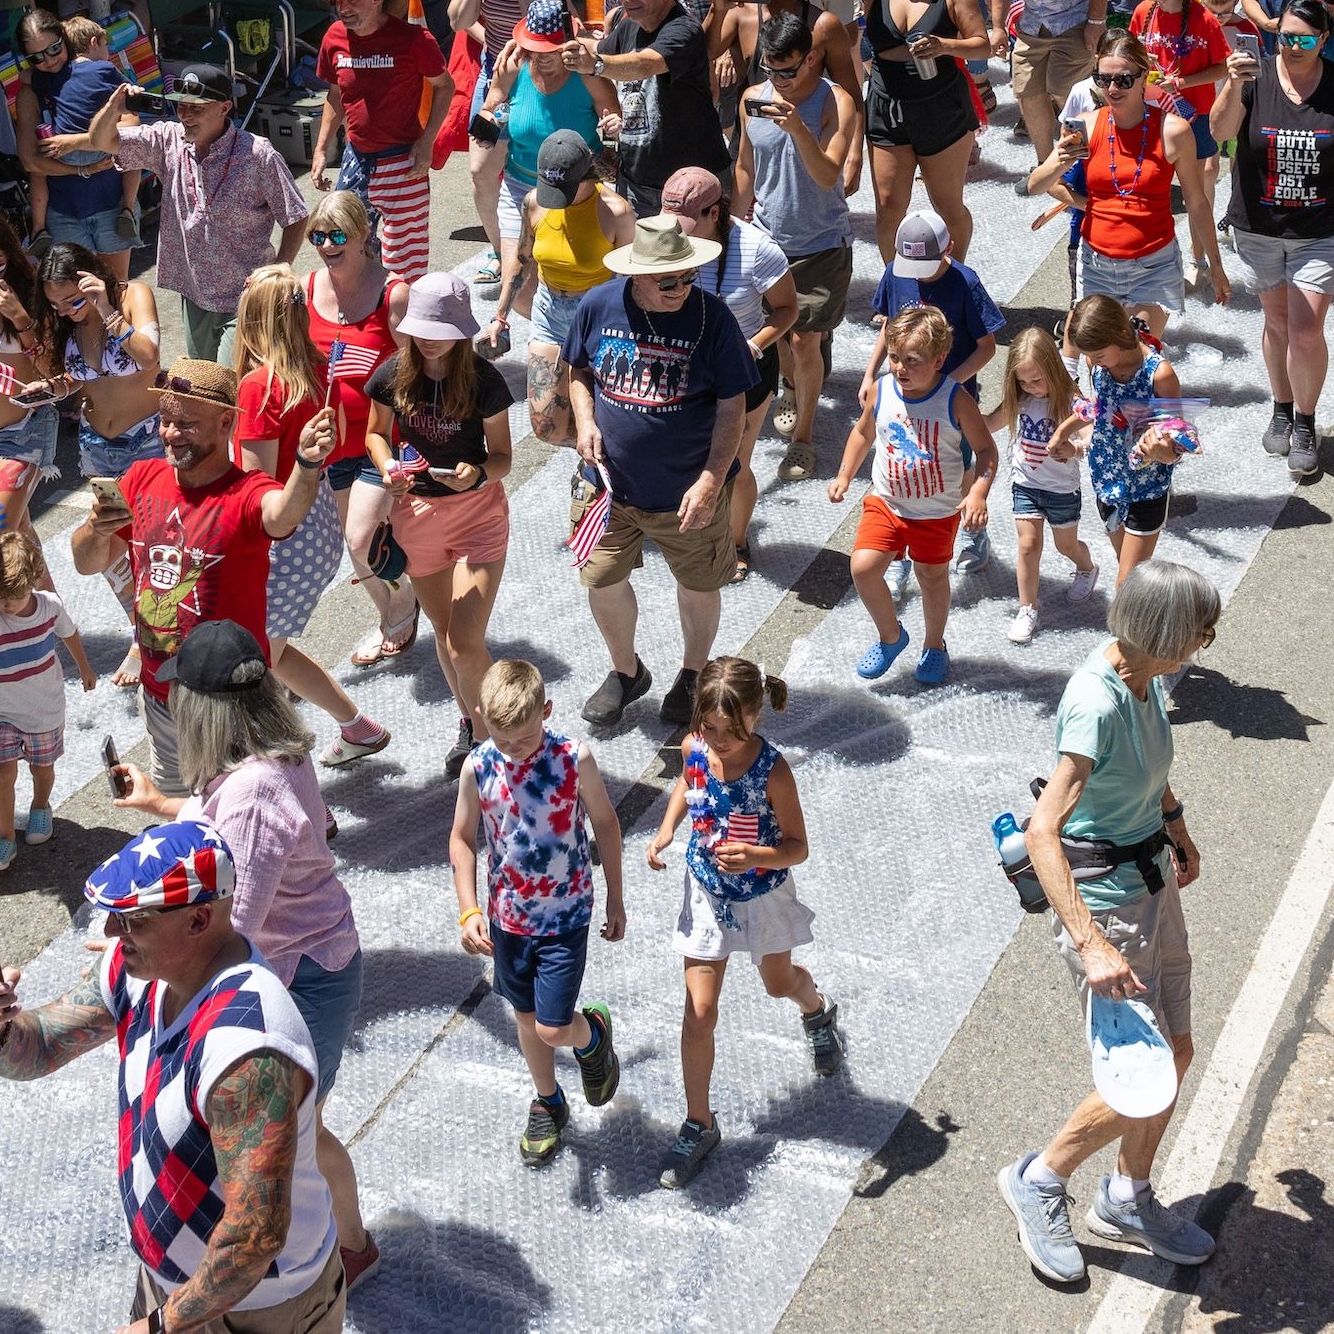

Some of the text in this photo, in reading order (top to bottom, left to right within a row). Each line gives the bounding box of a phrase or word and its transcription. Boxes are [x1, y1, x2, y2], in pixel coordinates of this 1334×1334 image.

[337, 54, 394, 70] Downievillain
[1267, 134, 1317, 150] TRUTH
[1267, 147, 1321, 163] REALLY
[1267, 160, 1321, 175] UPSETS
[1267, 172, 1305, 187] MOST
[1266, 185, 1318, 201] PEOPLE
[600, 327, 624, 338] LAND
[628, 330, 641, 340] OF
[647, 332, 666, 344] THE
[624, 403, 634, 411] OF
[637, 406, 653, 414] THE
[656, 404, 683, 413] BRAVE
[408, 415, 433, 430] LOVE
[437, 422, 462, 432] MARIE
